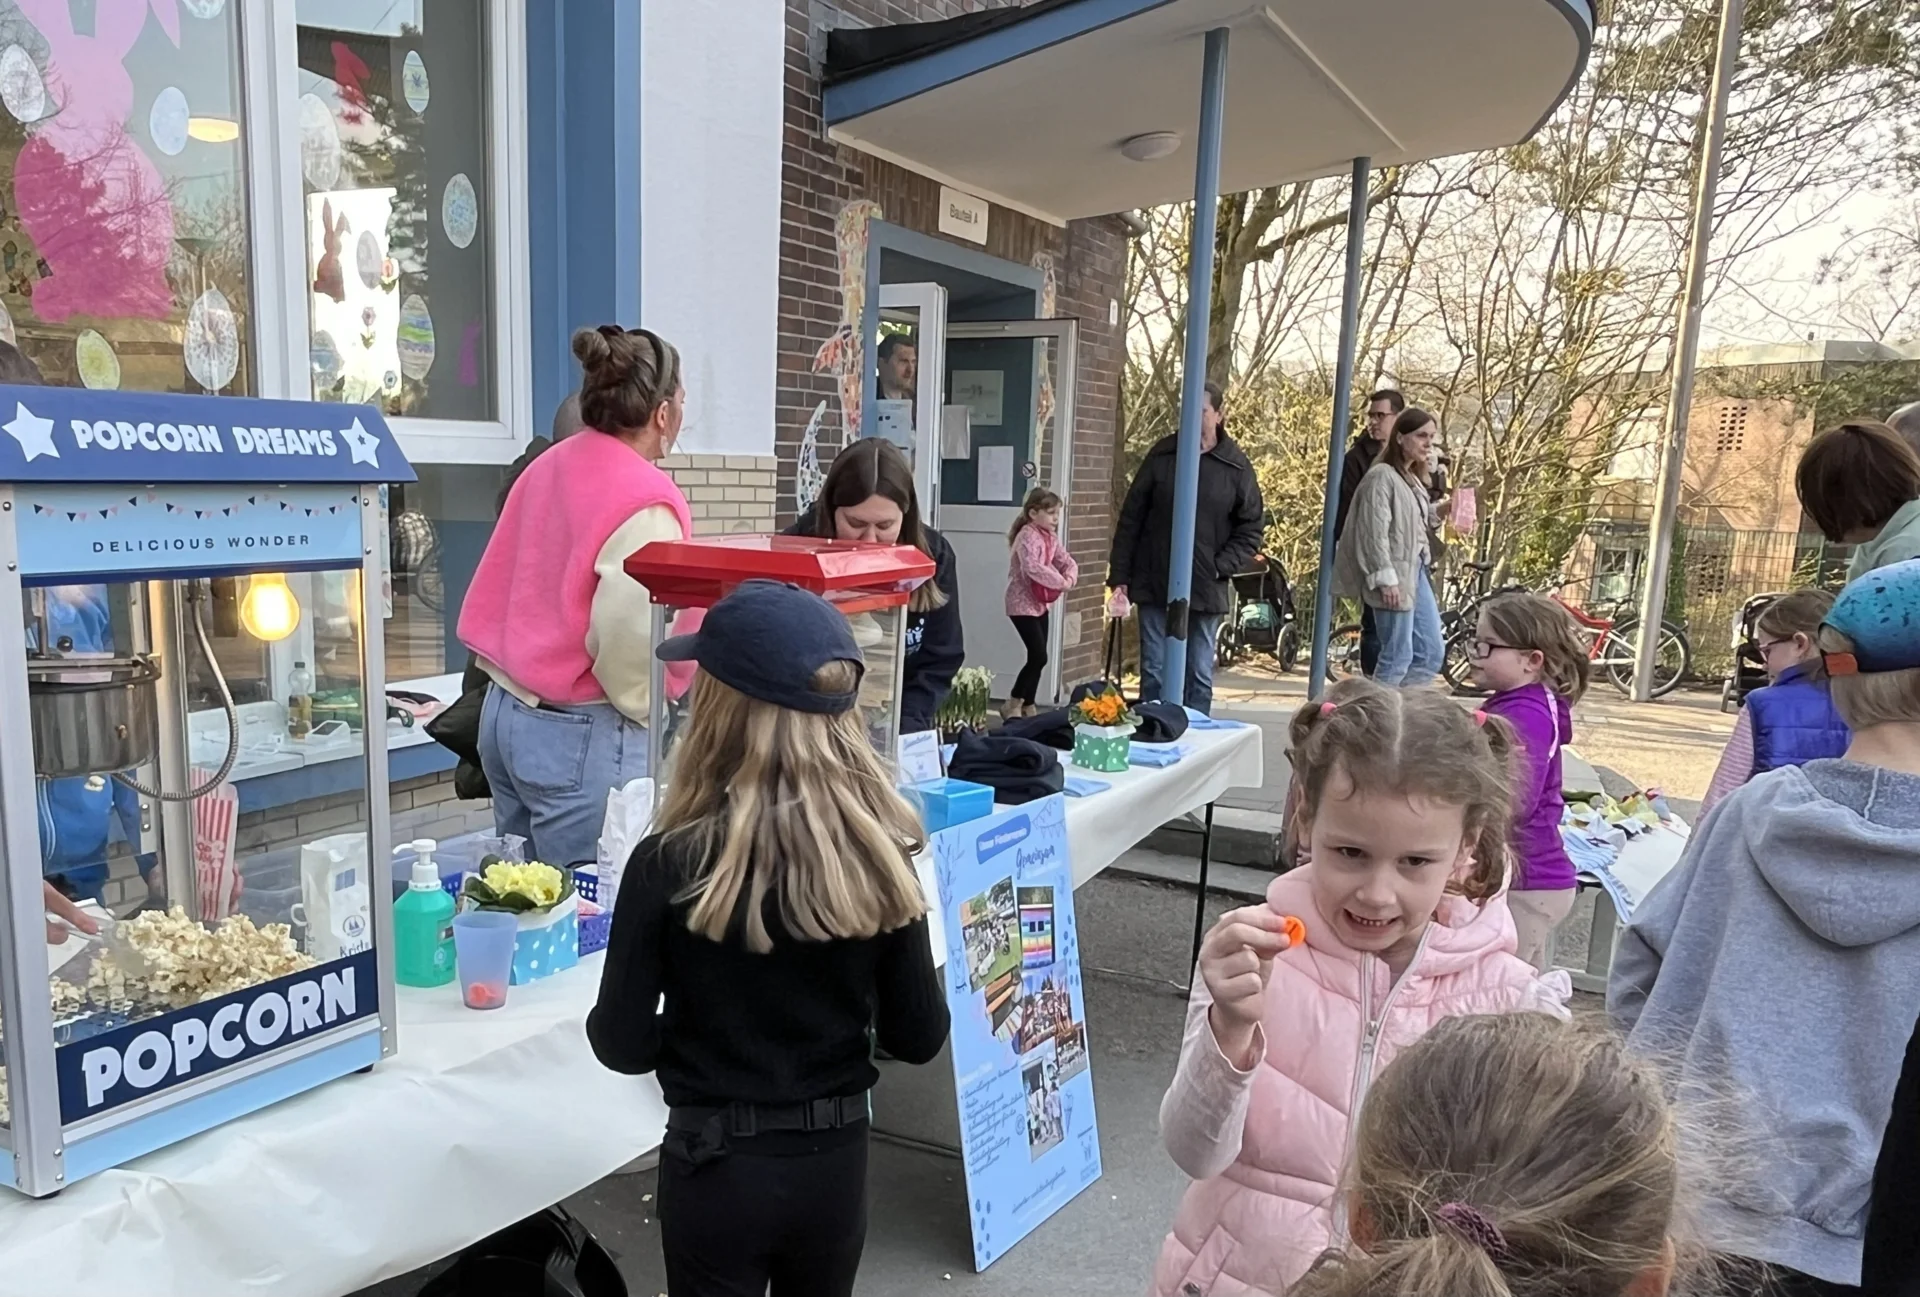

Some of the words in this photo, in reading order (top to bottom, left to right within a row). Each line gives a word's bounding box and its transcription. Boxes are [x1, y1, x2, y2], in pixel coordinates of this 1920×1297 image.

[70, 419, 224, 453] POPCORN
[232, 425, 338, 457] DREAMS
[92, 536, 215, 554] DELICIOUS
[228, 534, 311, 549] WONDER
[81, 966, 357, 1108] POPCORN
